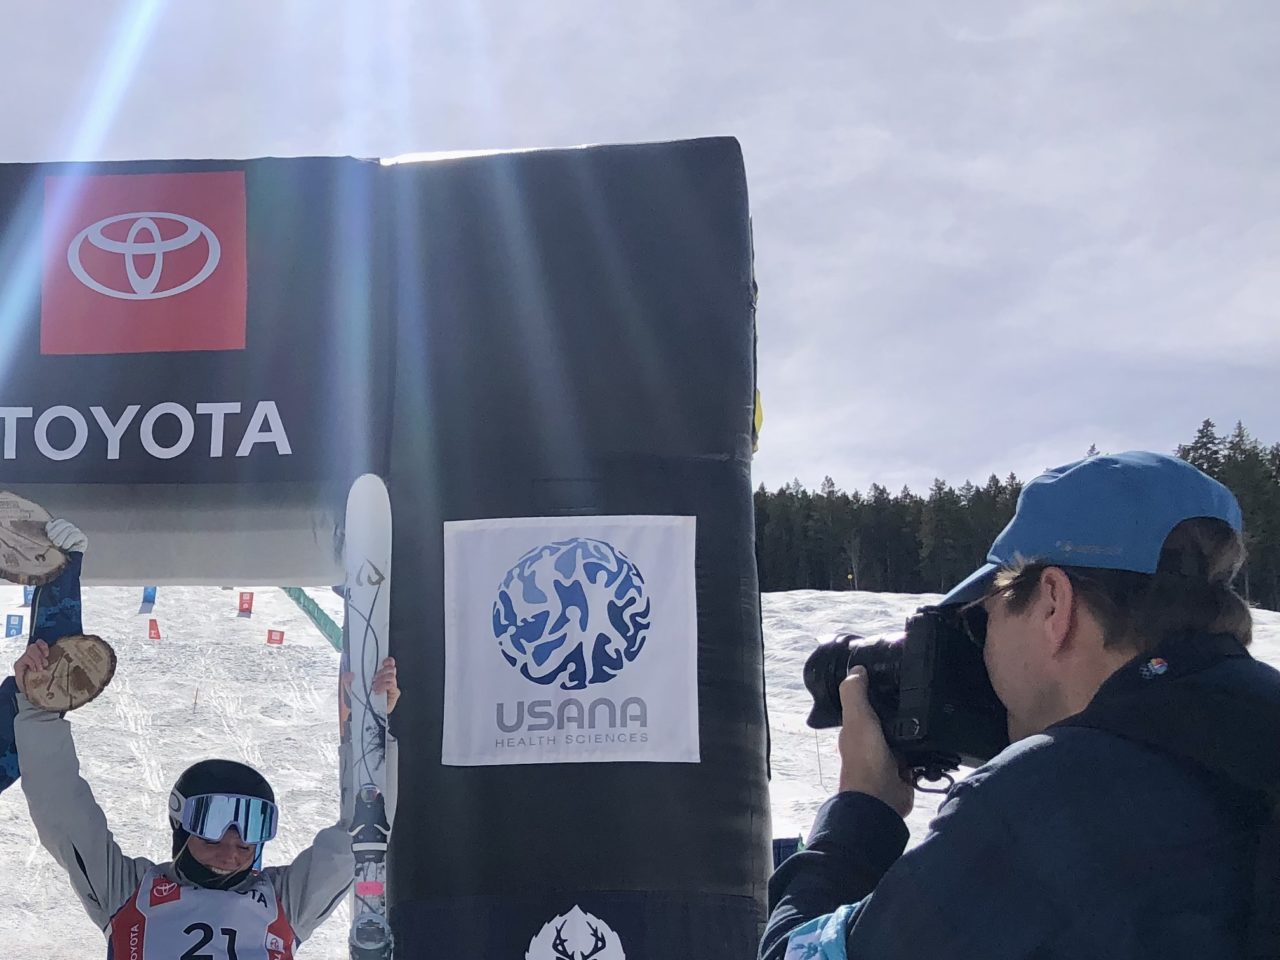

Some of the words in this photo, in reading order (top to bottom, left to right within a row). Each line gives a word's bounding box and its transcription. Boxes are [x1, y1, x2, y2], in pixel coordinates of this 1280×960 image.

[495, 696, 648, 732] USANA
[495, 736, 559, 749] HEALTH
[564, 731, 649, 744] SCIENCES
